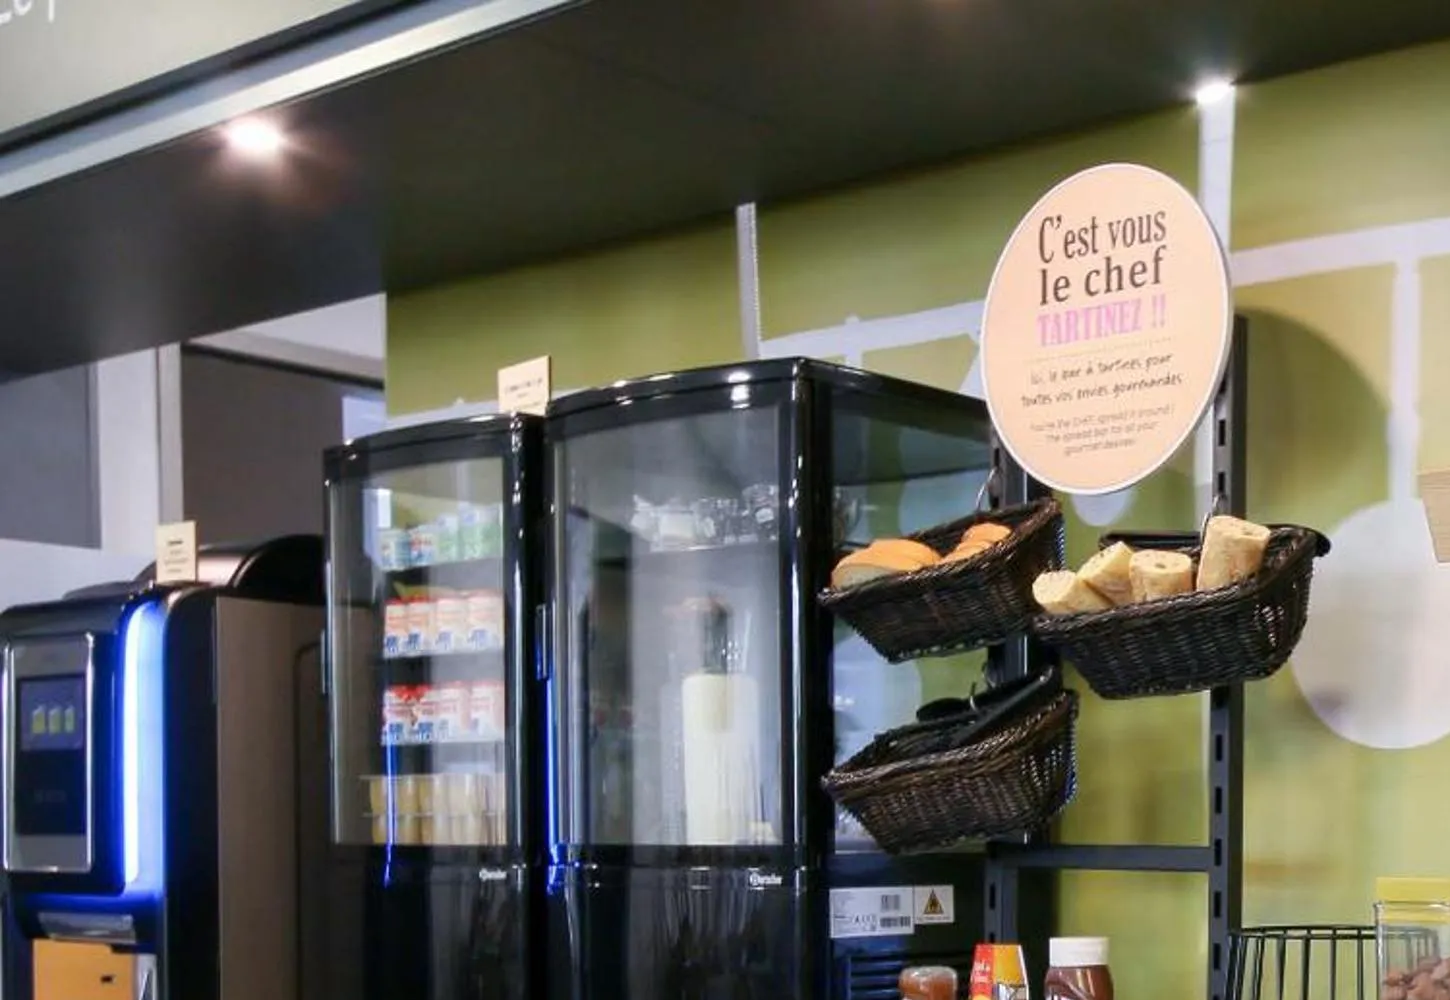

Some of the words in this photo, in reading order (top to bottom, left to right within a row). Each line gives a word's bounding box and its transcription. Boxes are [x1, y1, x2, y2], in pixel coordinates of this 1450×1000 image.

[1039, 214, 1098, 263] C'est
[1108, 211, 1166, 249] vous
[1040, 269, 1070, 306] le
[1084, 244, 1167, 297] chef
[1037, 297, 1142, 347] TARTINEZ
[1145, 353, 1173, 372] pour
[1020, 393, 1053, 408] toutes
[1055, 391, 1073, 402] vos
[1077, 386, 1108, 400] envies
[1113, 373, 1183, 398] gourmandes
